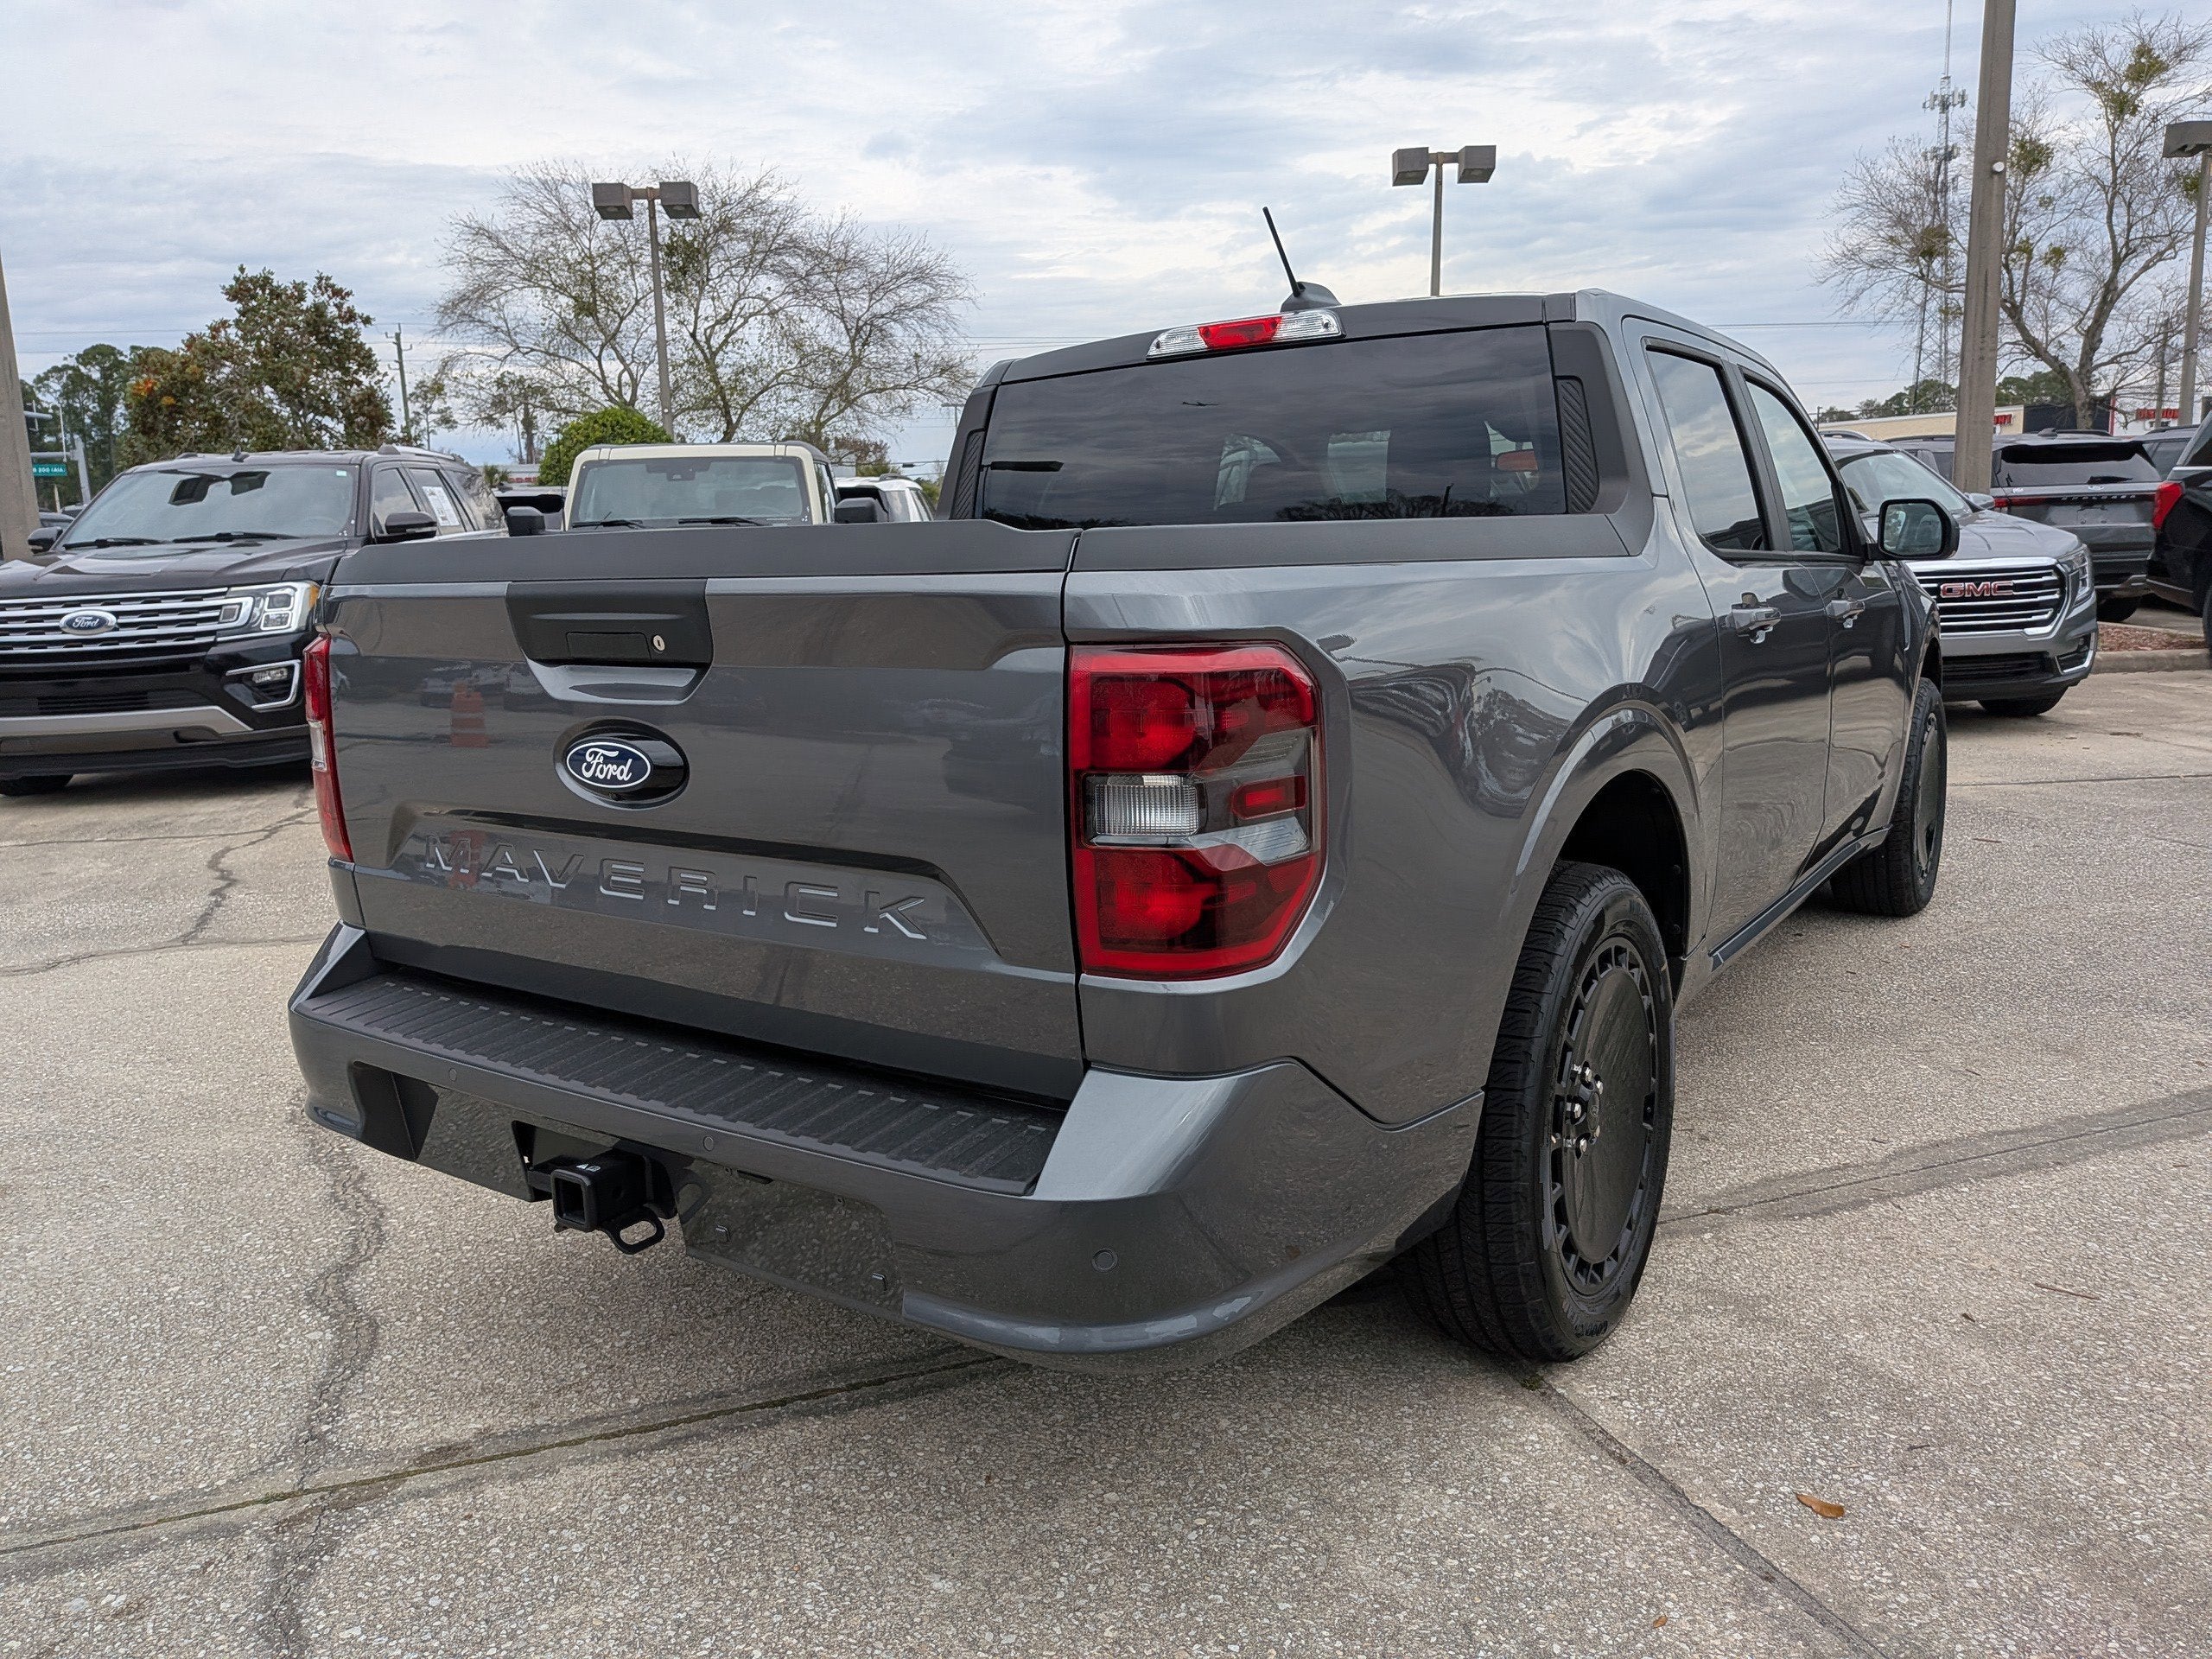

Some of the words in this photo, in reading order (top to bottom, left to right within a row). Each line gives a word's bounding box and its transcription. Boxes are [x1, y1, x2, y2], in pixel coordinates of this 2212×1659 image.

[1940, 581, 2013, 598] GMC
[72, 616, 100, 628] Ford
[582, 747, 632, 781] Ford
[424, 834, 928, 940] MAVERICK
